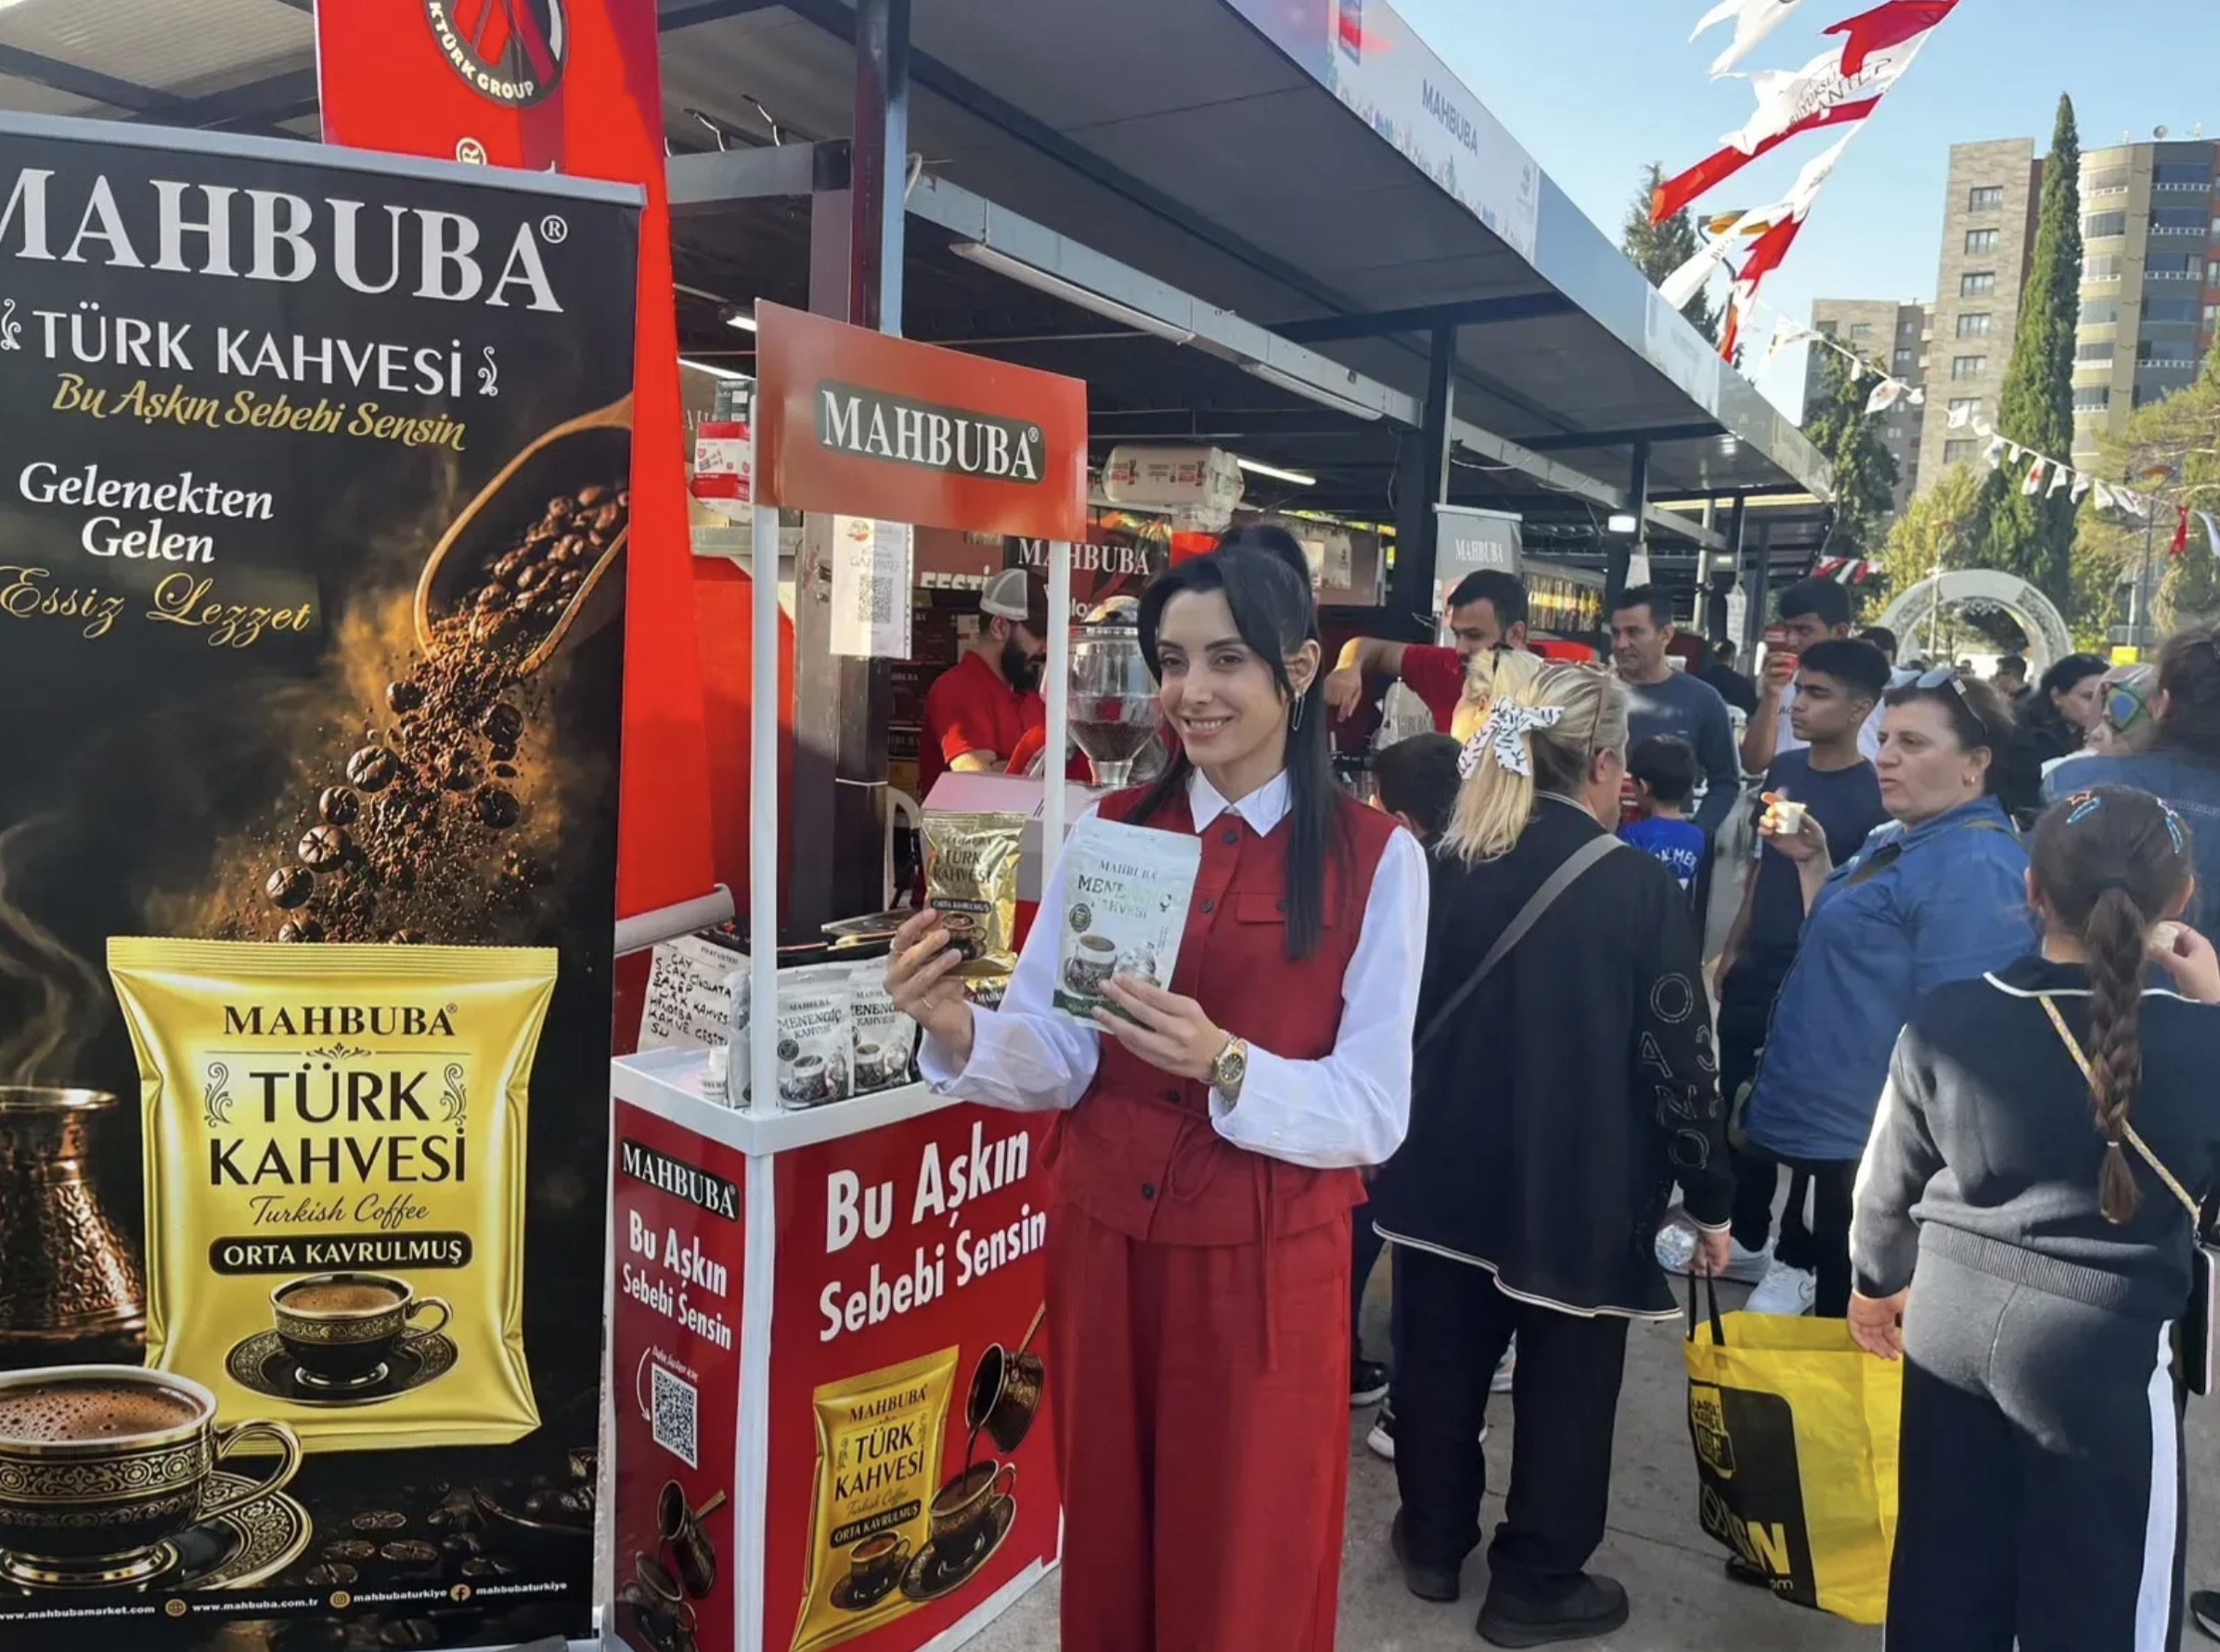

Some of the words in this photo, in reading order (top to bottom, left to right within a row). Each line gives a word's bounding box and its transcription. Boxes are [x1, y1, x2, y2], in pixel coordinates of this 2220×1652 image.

[476, 73, 535, 99] GROUP
[1421, 79, 1478, 157] MAHBUBA
[32, 301, 194, 371] TÜRK
[216, 327, 463, 397] KAHVESİ
[52, 373, 105, 419] Bu
[110, 381, 220, 428] Aşkın
[226, 390, 346, 433] Sebebi
[348, 401, 466, 451] Sensin
[19, 462, 274, 520] Gelenekten
[82, 516, 214, 563] Gelen
[146, 572, 311, 648] Lezzet
[249, 1062, 430, 1123] TÜRK
[210, 1126, 466, 1186] KAHVESİ
[249, 1194, 345, 1226] Turkish
[354, 1194, 430, 1230] Coffee
[826, 1169, 893, 1253] Bu
[911, 1120, 1029, 1228] Aşkın
[223, 1243, 296, 1267] ORTA
[305, 1239, 464, 1265] KAVRULMUŞ
[629, 1208, 656, 1260] Bu
[664, 1227, 728, 1297] Aşkın
[820, 1244, 945, 1342] Sebebi
[956, 1204, 1047, 1286] Sensin
[623, 1262, 674, 1319] Sebebi
[678, 1291, 731, 1351] Sensin
[835, 1444, 924, 1502] KAHVESİ
[856, 1421, 915, 1465] TÜRK
[834, 1523, 861, 1542] ORTA
[192, 1598, 318, 1612] www.mahbuba.com.tr
[354, 1589, 447, 1603] mahbubaturkiye
[476, 1581, 568, 1595] mahbubaturkiye
